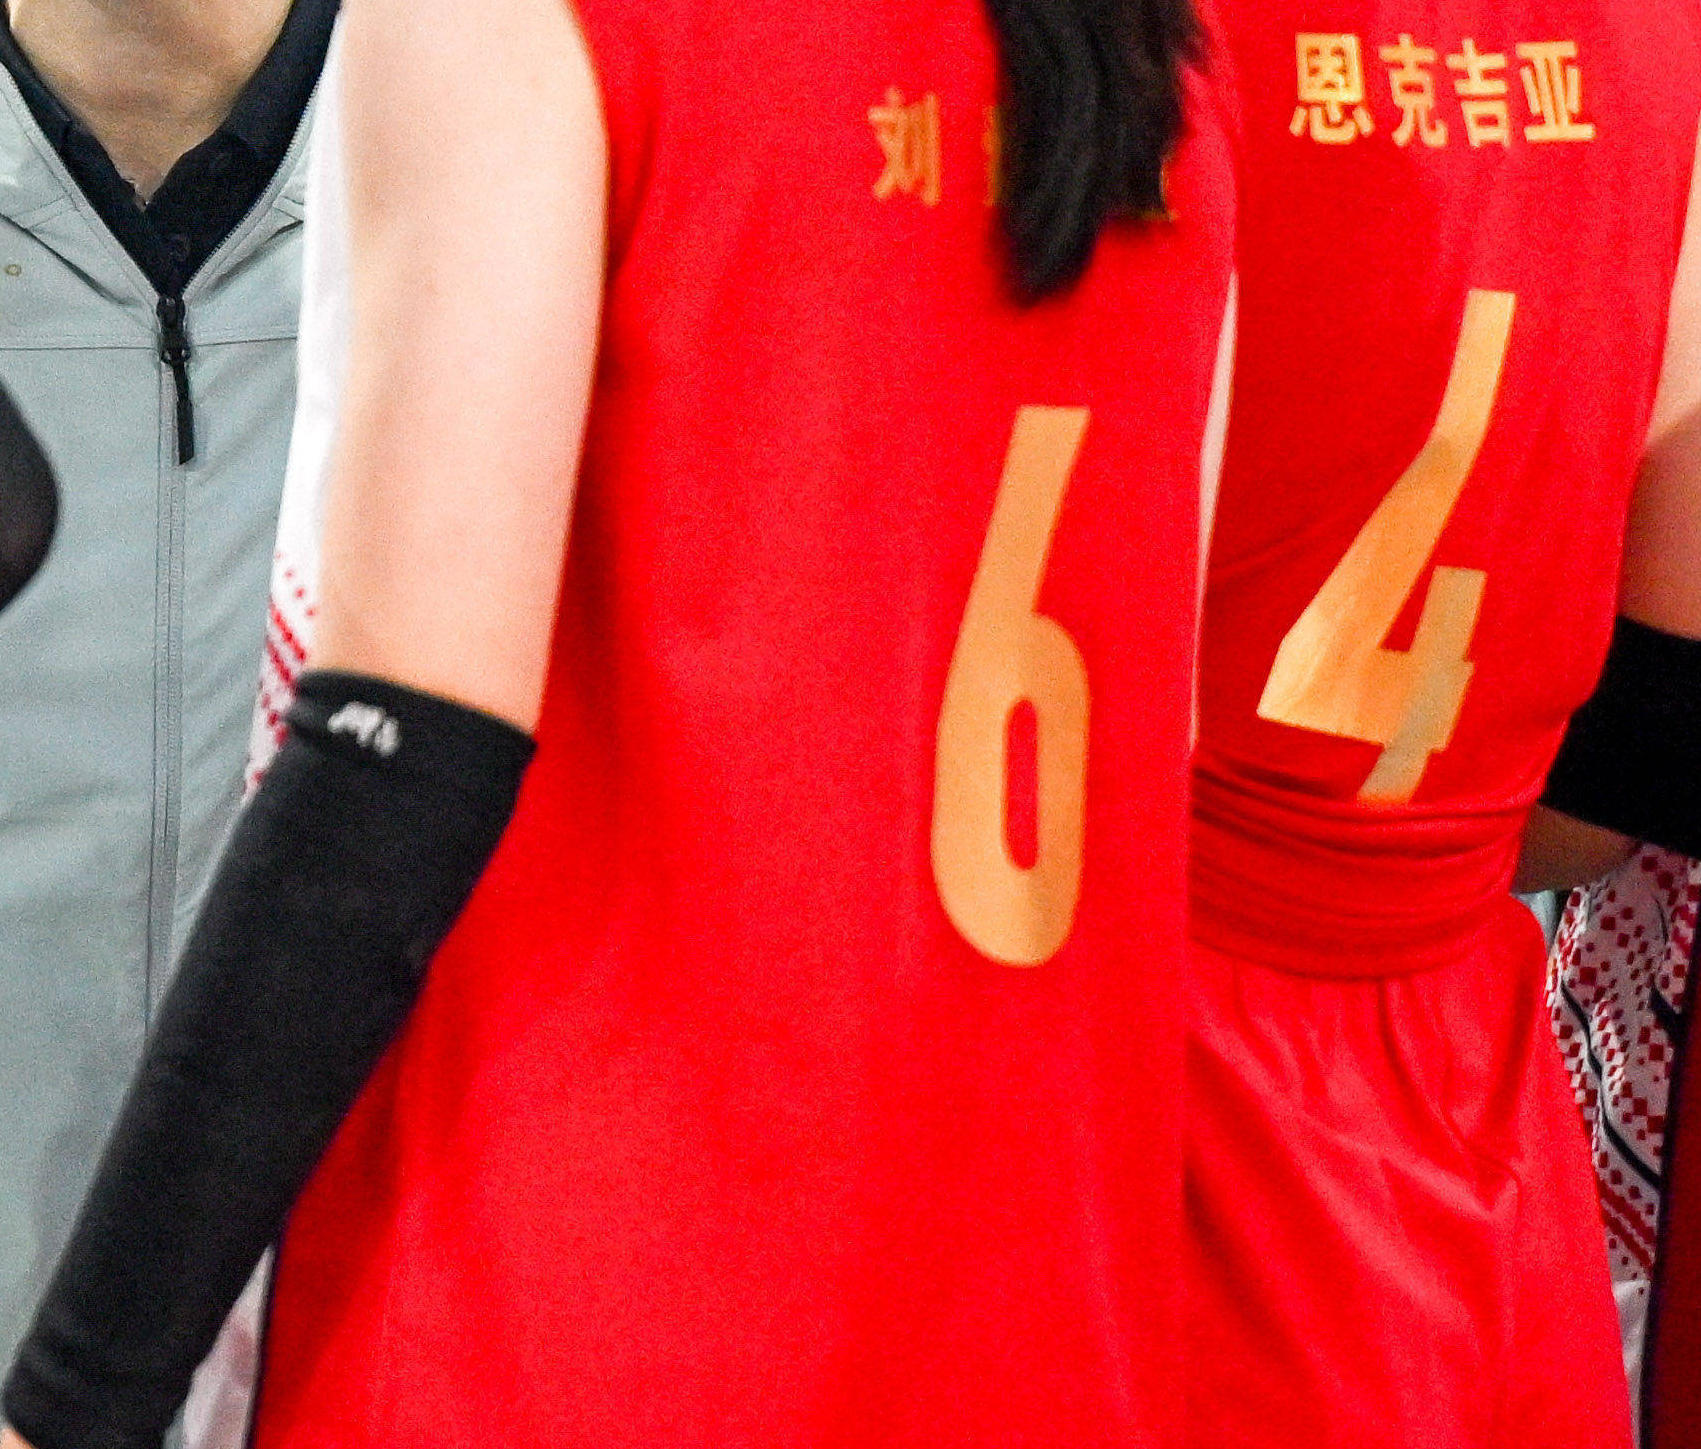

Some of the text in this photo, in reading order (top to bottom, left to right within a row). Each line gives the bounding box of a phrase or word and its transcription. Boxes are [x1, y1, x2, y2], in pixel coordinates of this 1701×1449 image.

[1288, 31, 1596, 148] 恩克吉亚
[931, 406, 1091, 969] 6
[1257, 289, 1516, 808] 4
